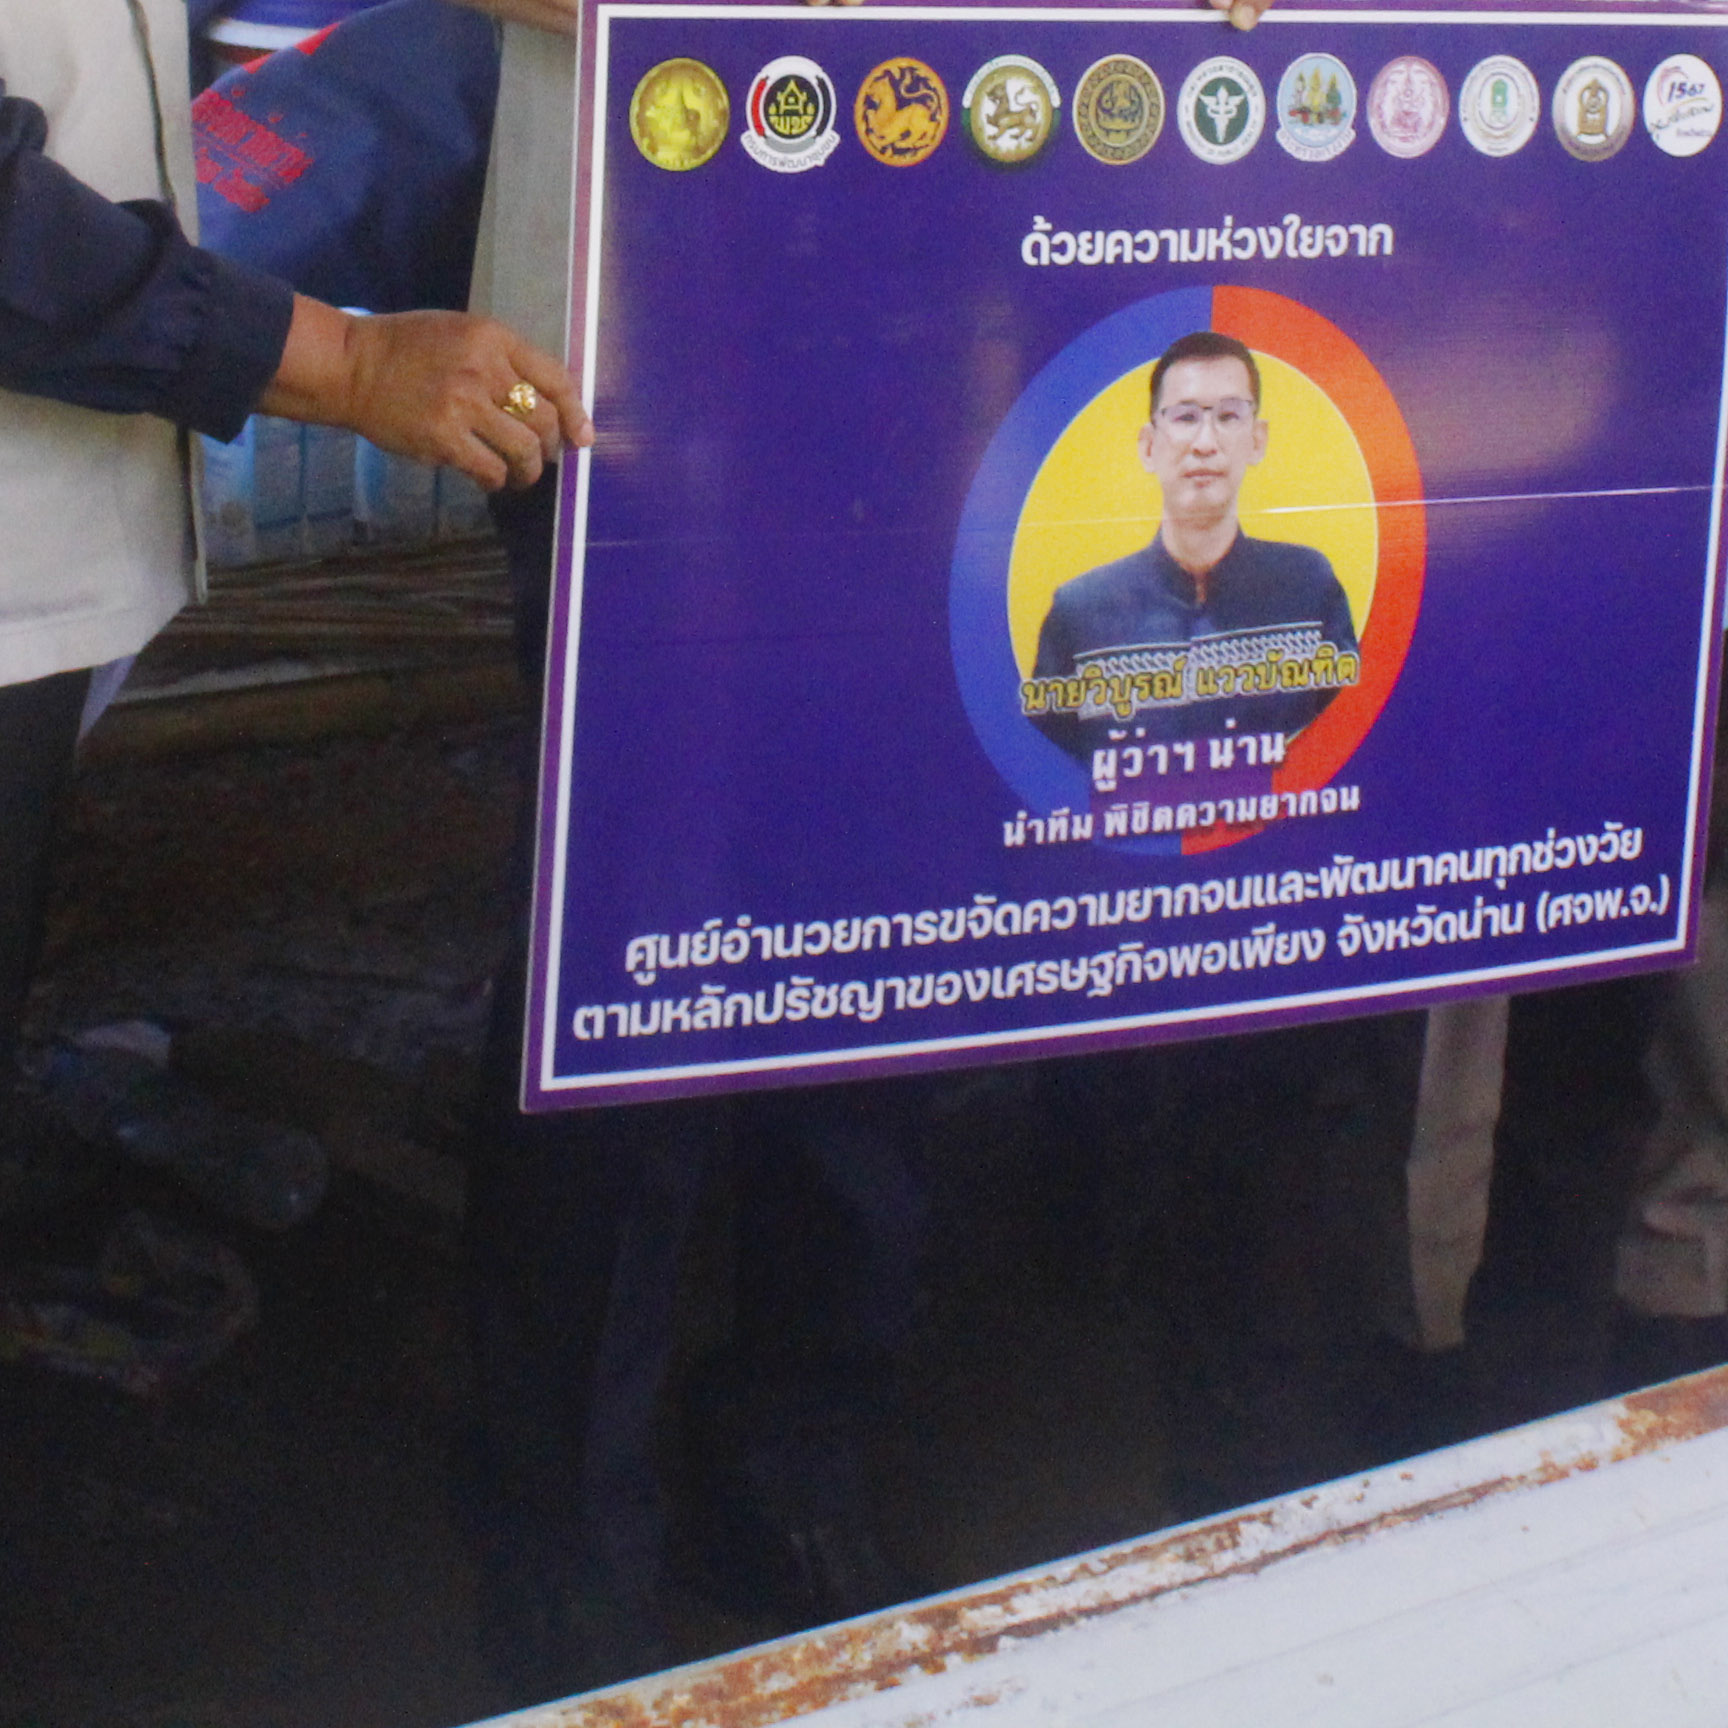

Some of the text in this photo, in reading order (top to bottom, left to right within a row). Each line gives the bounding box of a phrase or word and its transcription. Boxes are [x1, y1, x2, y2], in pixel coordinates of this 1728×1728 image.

[1020, 213, 1395, 266] ด้วยความห่วงใยจาก
[1022, 644, 1358, 717] นายวิบูรณ์ แววบัณฑิต
[1091, 717, 1286, 792] ผู้ว่าฯ น่าน
[1003, 785, 1361, 847] นำทีม พิชิตความยากจน
[625, 821, 1644, 986] ศูนย์อำนวยการขจัดความยากจนและพัฒนาคนทุกช่วงวัย
[572, 872, 1671, 1040] ตามหลักปรัชญาของเศรษฐกิจพอเพียง จังหวัดน่าน (ศจพ.จ.)
